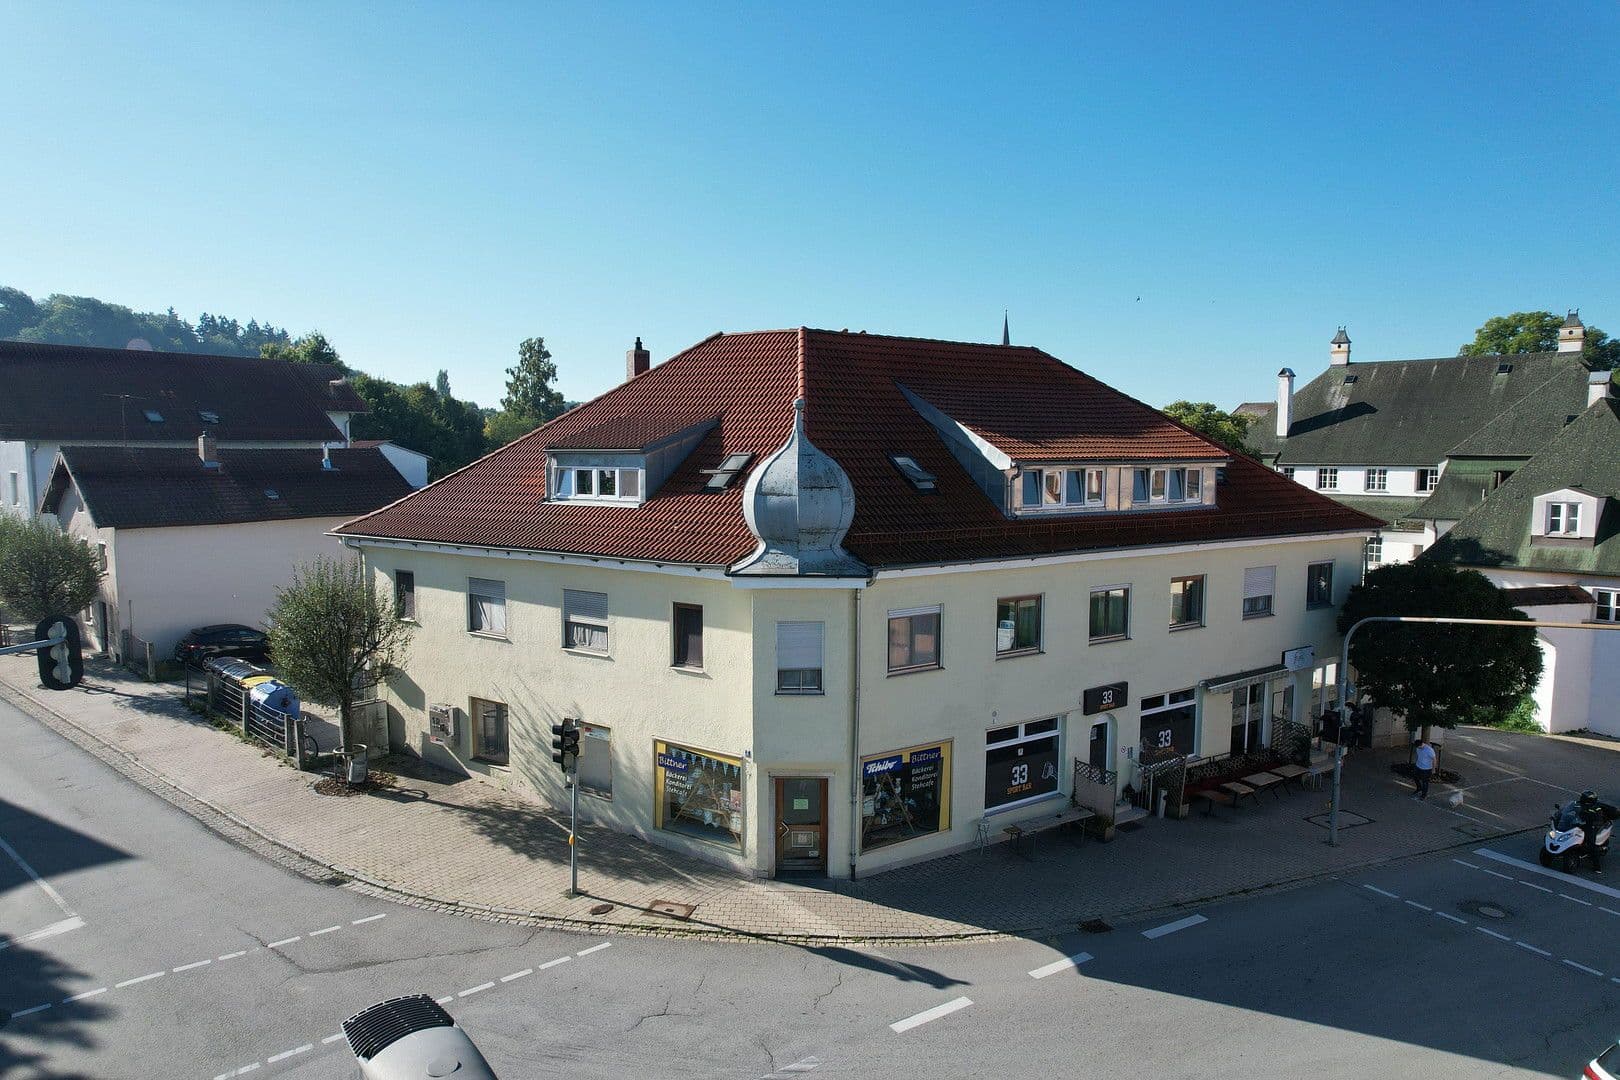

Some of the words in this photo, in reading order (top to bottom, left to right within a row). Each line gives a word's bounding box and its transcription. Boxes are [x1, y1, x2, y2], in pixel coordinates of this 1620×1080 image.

[1102, 690, 1113, 704] 33
[1158, 729, 1172, 748] 33
[659, 756, 687, 768] Bittner
[911, 751, 940, 764] Bittner
[866, 760, 898, 774] Tchibo
[1012, 764, 1028, 786] 33
